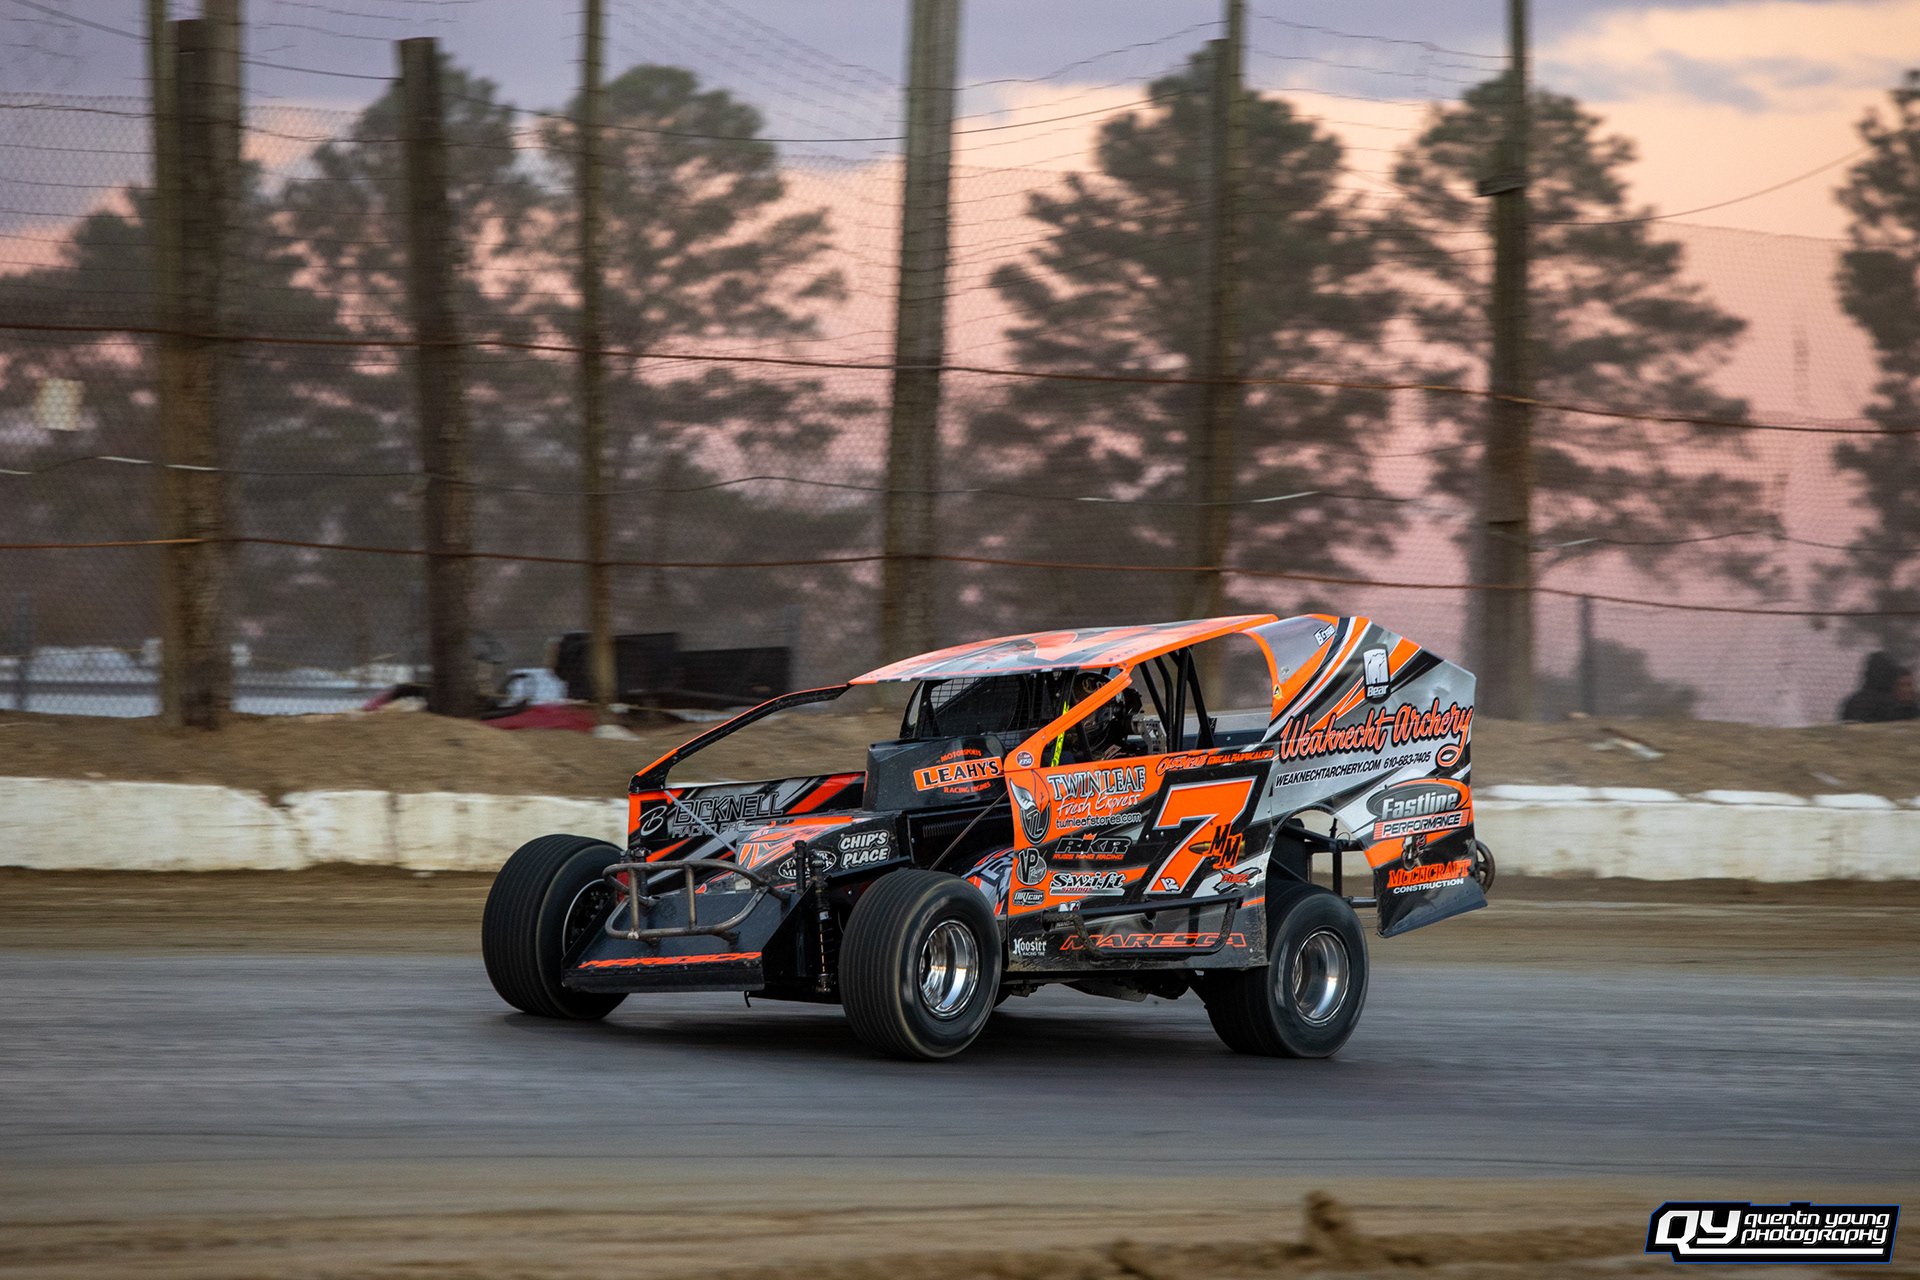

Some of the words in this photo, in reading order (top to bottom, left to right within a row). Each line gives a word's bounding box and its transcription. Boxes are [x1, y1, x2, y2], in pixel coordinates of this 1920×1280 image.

[1367, 685, 1389, 697] Bear
[1280, 707, 1395, 761] Weaknecht
[922, 760, 999, 787] LEAHY'S
[1275, 761, 1381, 787] WEAKNECHTARCHERY.COM
[1383, 751, 1432, 769] 610-683-7405
[672, 793, 784, 826] BICKNELL
[1057, 789, 1093, 817] Fresh
[1095, 787, 1141, 815] Express
[1382, 791, 1459, 820] Fastline
[1056, 812, 1142, 830] twinleafstores.com
[1382, 812, 1463, 836] PERFORMANCE
[839, 830, 890, 851] CHIP'S
[1143, 775, 1259, 895] 7
[841, 848, 890, 868] PLACE
[1018, 848, 1040, 884] VP
[1050, 871, 1127, 891] Swift
[1387, 859, 1472, 888] MULTICRAFT
[1061, 886, 1093, 894] springs
[1393, 878, 1465, 895] CONSTRUCTION
[1012, 937, 1048, 956] Hoosier
